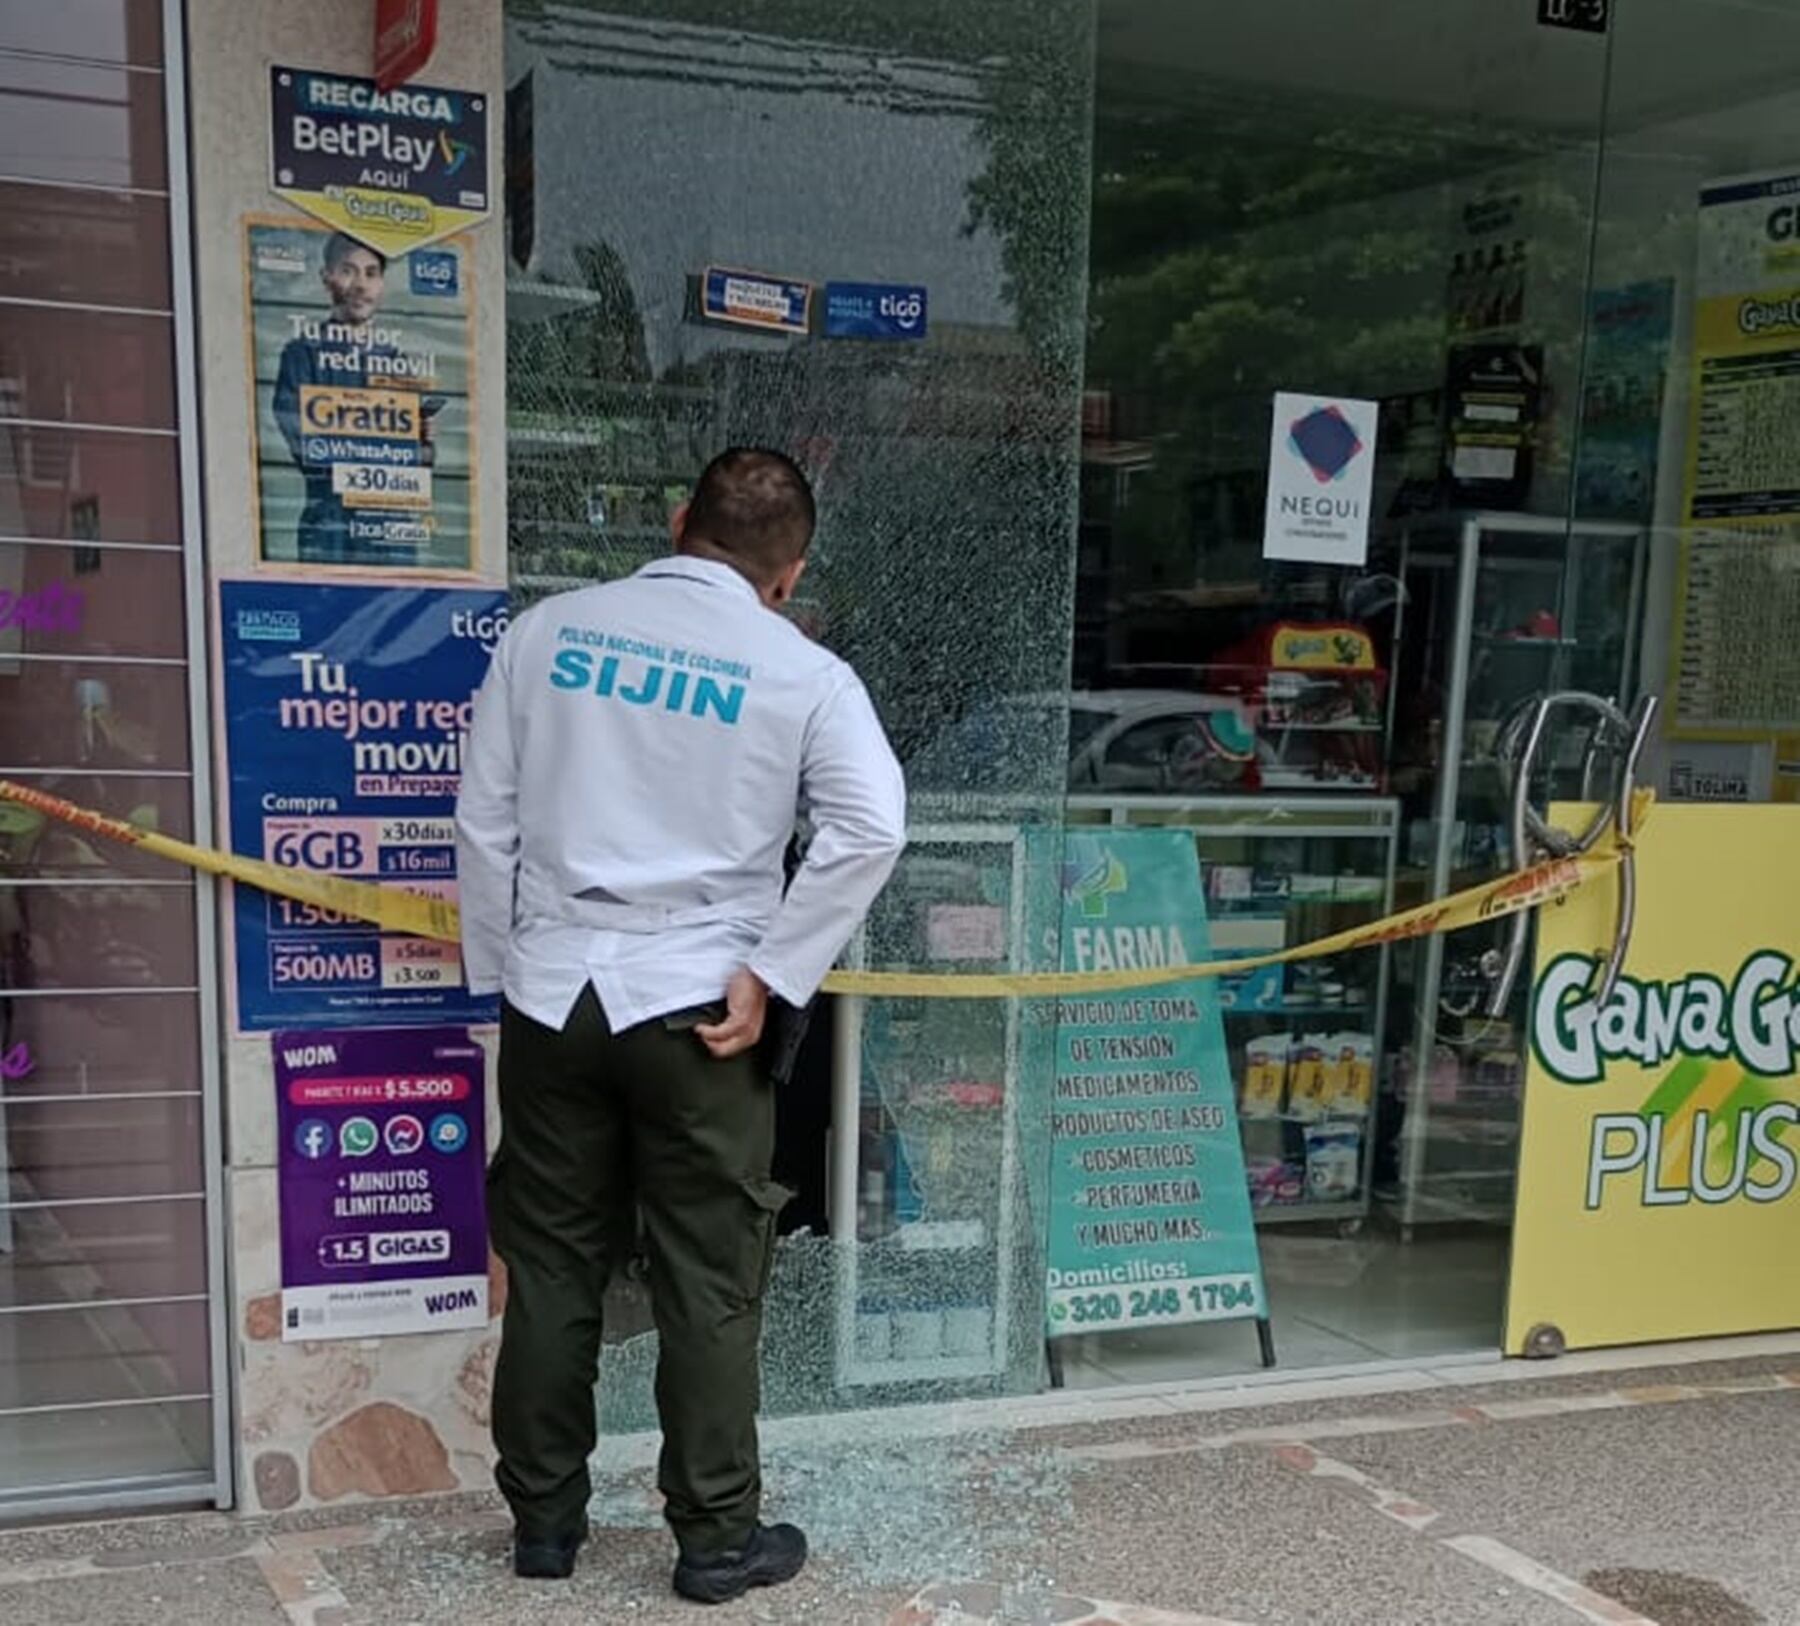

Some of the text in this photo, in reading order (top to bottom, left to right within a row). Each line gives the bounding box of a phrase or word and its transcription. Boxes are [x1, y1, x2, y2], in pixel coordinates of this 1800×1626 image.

[308, 80, 454, 120] RECARGA
[293, 115, 435, 172] BetPlay
[880, 293, 921, 329] tigo
[287, 313, 404, 350] Tu mejor
[318, 347, 360, 371] red
[305, 395, 413, 434] Gratis
[330, 441, 415, 464] WhatsApp
[1279, 496, 1359, 519] NEQUI
[605, 636, 666, 660] NACIONAL
[669, 648, 687, 665] DE
[688, 653, 752, 680] COLOMBIA
[290, 652, 347, 693] Tu
[550, 647, 745, 724] SIJIN
[280, 686, 407, 740] mejor
[360, 777, 383, 792] en
[1695, 779, 1748, 795] TOLIMA
[262, 793, 338, 814] Compra
[273, 831, 364, 871] 6GB
[1072, 925, 1189, 973] FARMA
[275, 953, 376, 981] 500MB
[1123, 1000, 1144, 1022] DE
[1152, 998, 1200, 1022] TOMA
[282, 1045, 338, 1070] WOM
[1070, 1037, 1093, 1062] DE
[1056, 1071, 1200, 1100] MEDICAMENTOS
[1152, 1111, 1173, 1132] DE
[1181, 1106, 1225, 1131] ASEO
[1585, 1100, 1800, 1210] PLUS
[349, 1169, 430, 1193] MINUTOS
[334, 1193, 433, 1217] ILIMITADOS
[375, 1235, 446, 1258] GIGAS
[1077, 1225, 1089, 1247] Y
[1093, 1221, 1159, 1247] MUCHO
[424, 1288, 479, 1315] WOM
[1069, 1293, 1123, 1323] 320
[1187, 1280, 1255, 1312] 1794
